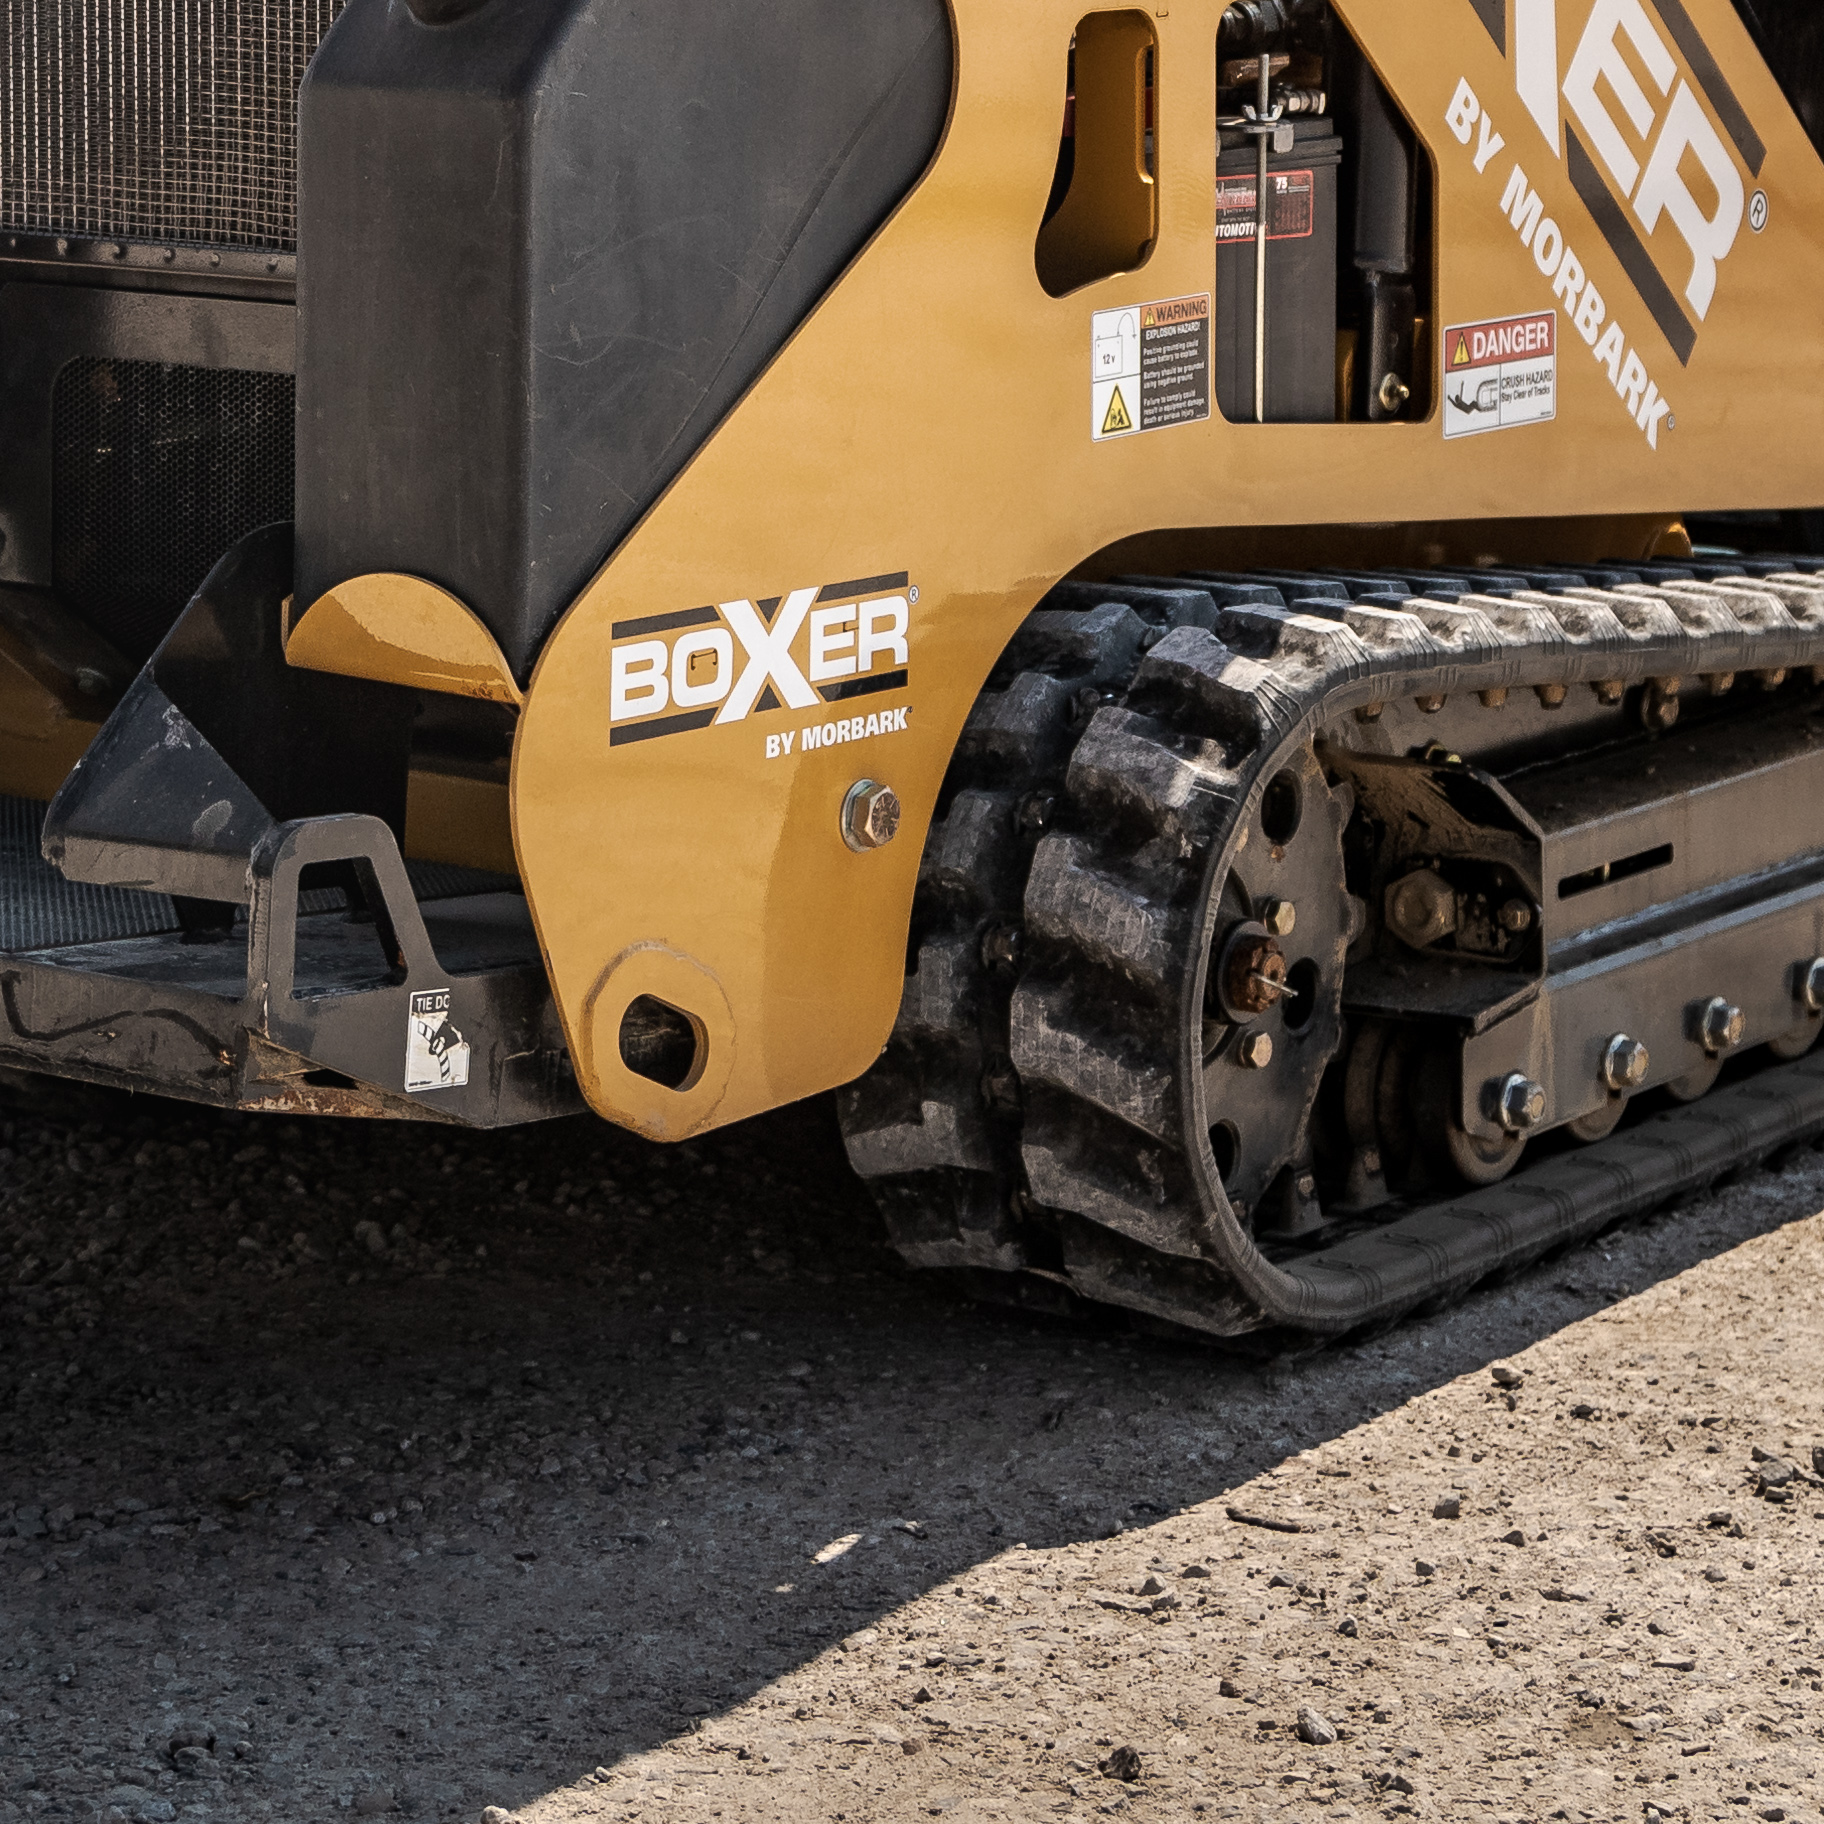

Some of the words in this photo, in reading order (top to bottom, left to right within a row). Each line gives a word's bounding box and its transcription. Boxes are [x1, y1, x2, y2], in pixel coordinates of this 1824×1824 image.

[1276, 176, 1288, 190] 75
[1445, 76, 1505, 177] BY
[1501, 164, 1672, 451] MORBARK
[1156, 300, 1207, 322] WARNING
[1146, 326, 1177, 341] EXPLOSION
[1177, 321, 1200, 335] HAZARD!
[1473, 321, 1549, 360] DANGER
[1501, 375, 1525, 389] CRUSH
[1526, 369, 1553, 383] HAZARD
[1501, 392, 1513, 404] Stay
[1514, 390, 1527, 400] Clear
[1527, 388, 1534, 397] of
[1534, 386, 1551, 396] Tracks
[610, 586, 909, 726] BOXER
[765, 731, 796, 759] BY
[801, 707, 908, 752] MORBARK
[416, 996, 433, 1012] TIE
